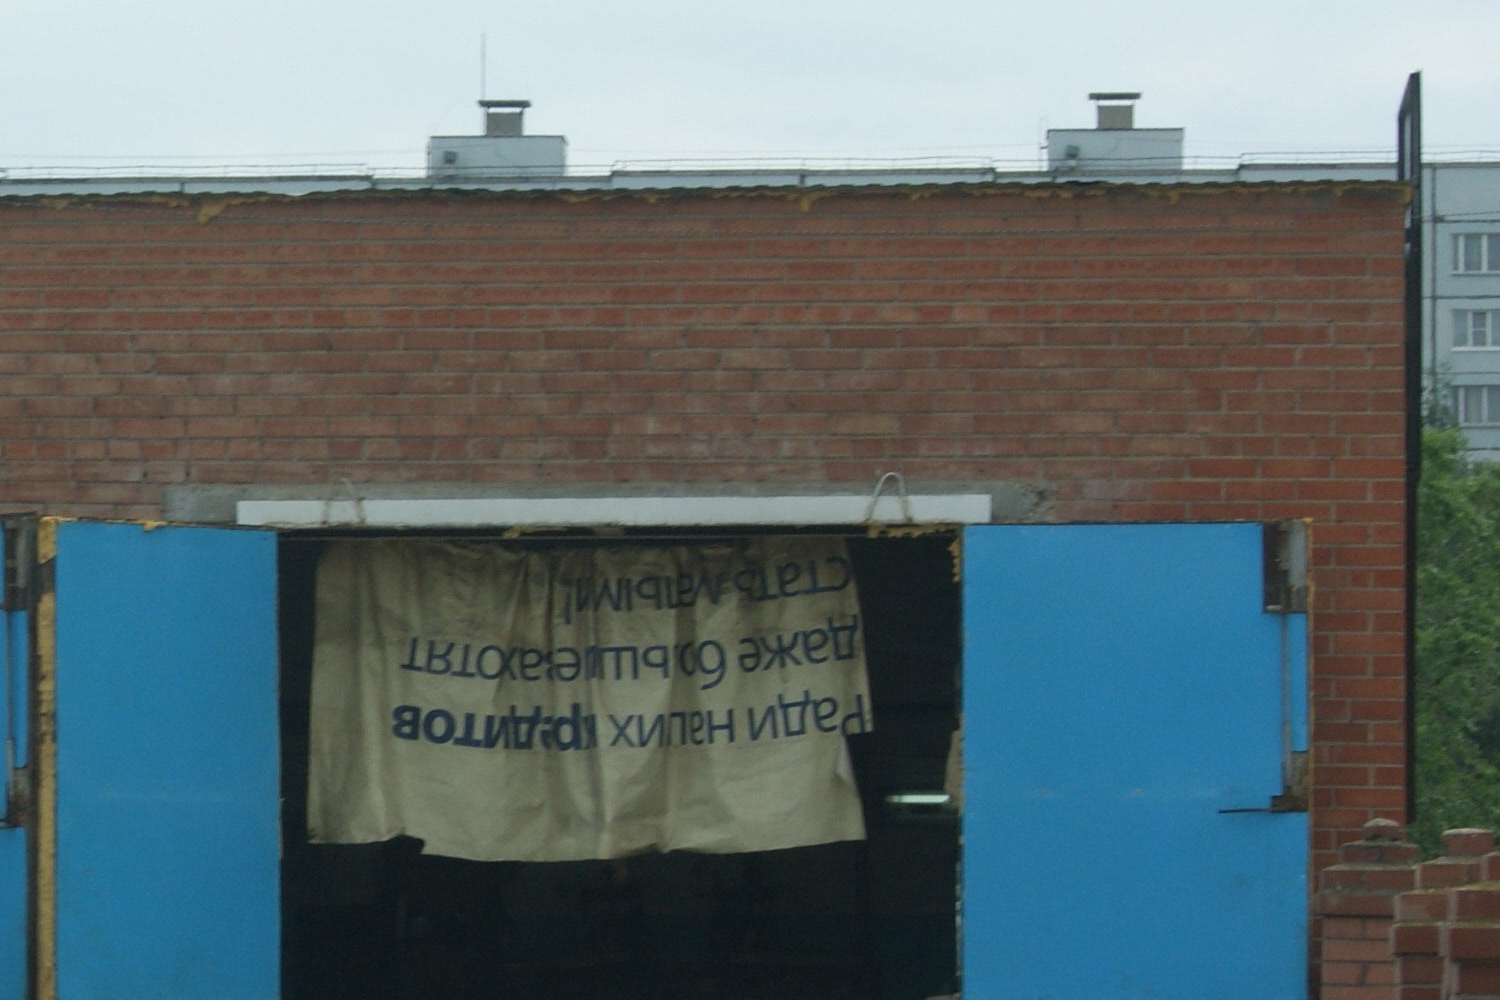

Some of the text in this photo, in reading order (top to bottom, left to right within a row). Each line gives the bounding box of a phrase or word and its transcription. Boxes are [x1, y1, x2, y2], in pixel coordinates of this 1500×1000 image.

[731, 556, 853, 597] стать
[551, 639, 727, 690] боьшие
[738, 614, 859, 671] даже
[748, 693, 866, 740] Ради
